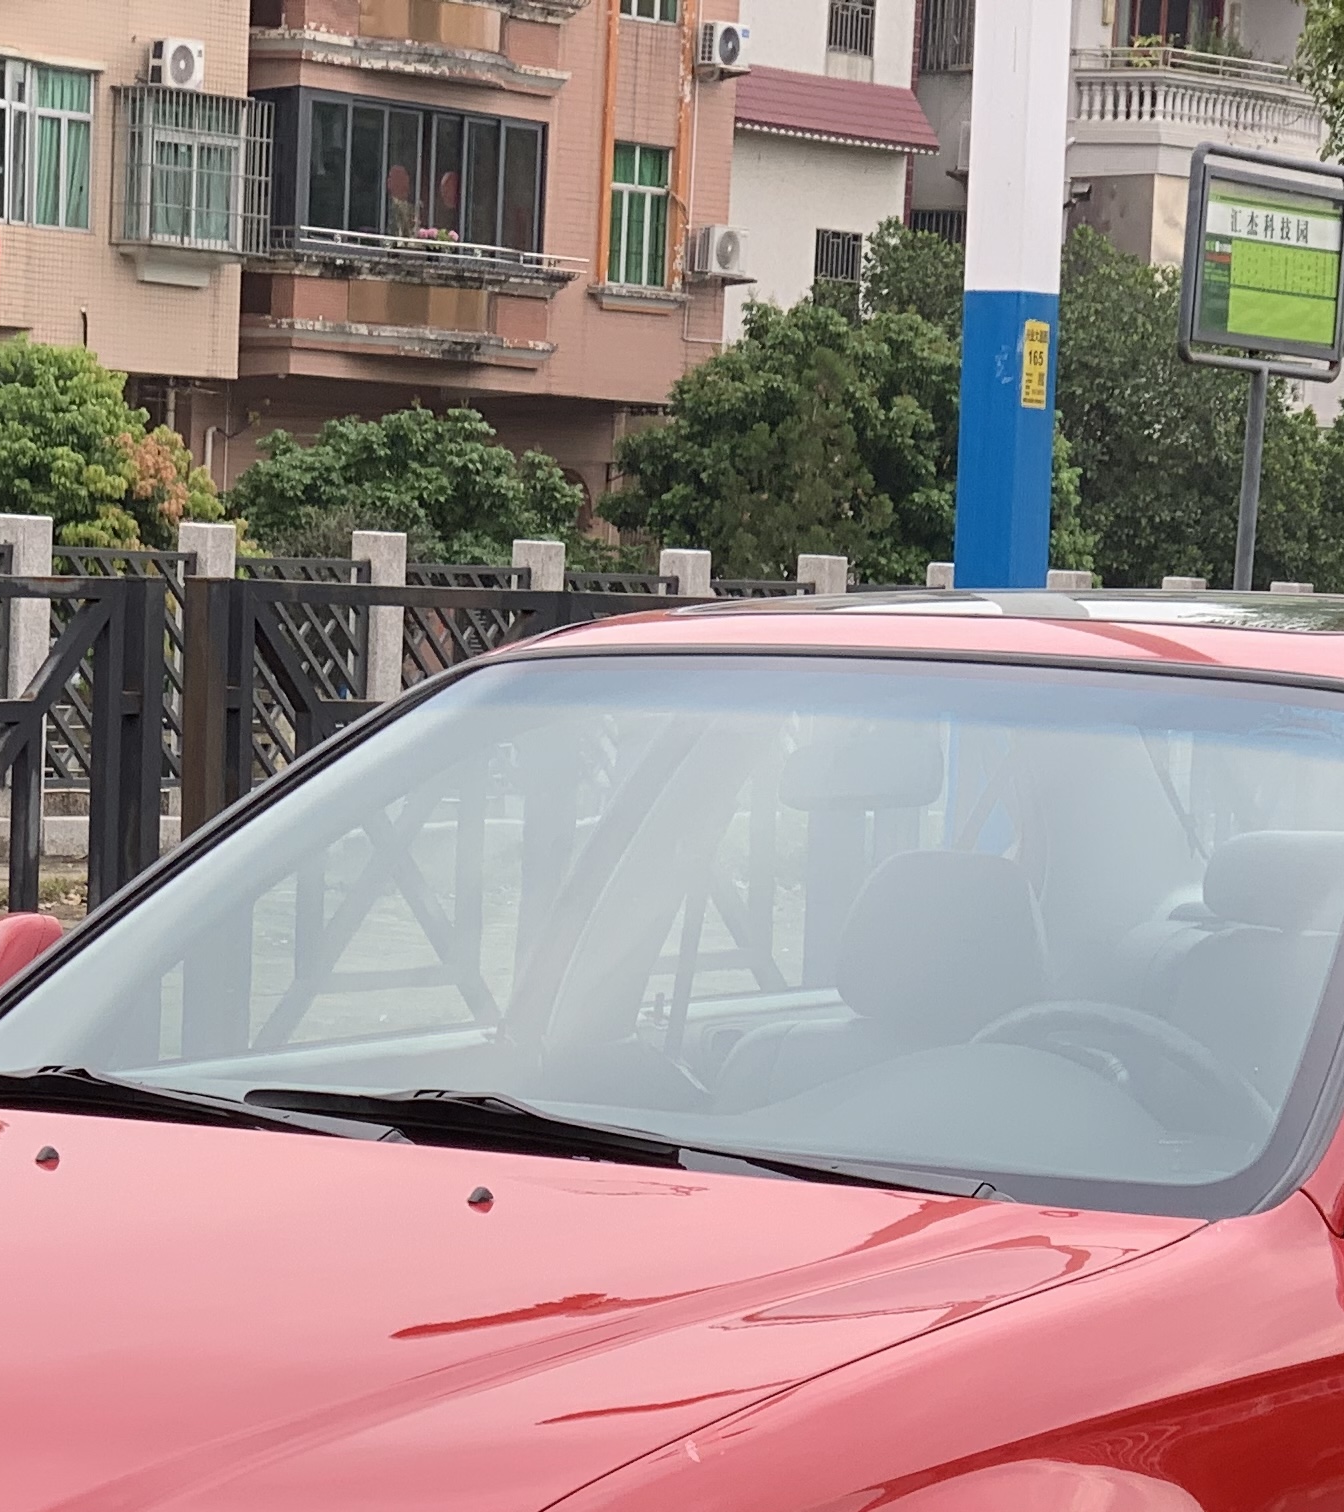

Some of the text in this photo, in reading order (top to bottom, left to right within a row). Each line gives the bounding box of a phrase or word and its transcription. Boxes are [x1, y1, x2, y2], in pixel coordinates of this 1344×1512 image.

[1230, 208, 1309, 244] 汇杰科技园
[1029, 350, 1044, 366] 165
